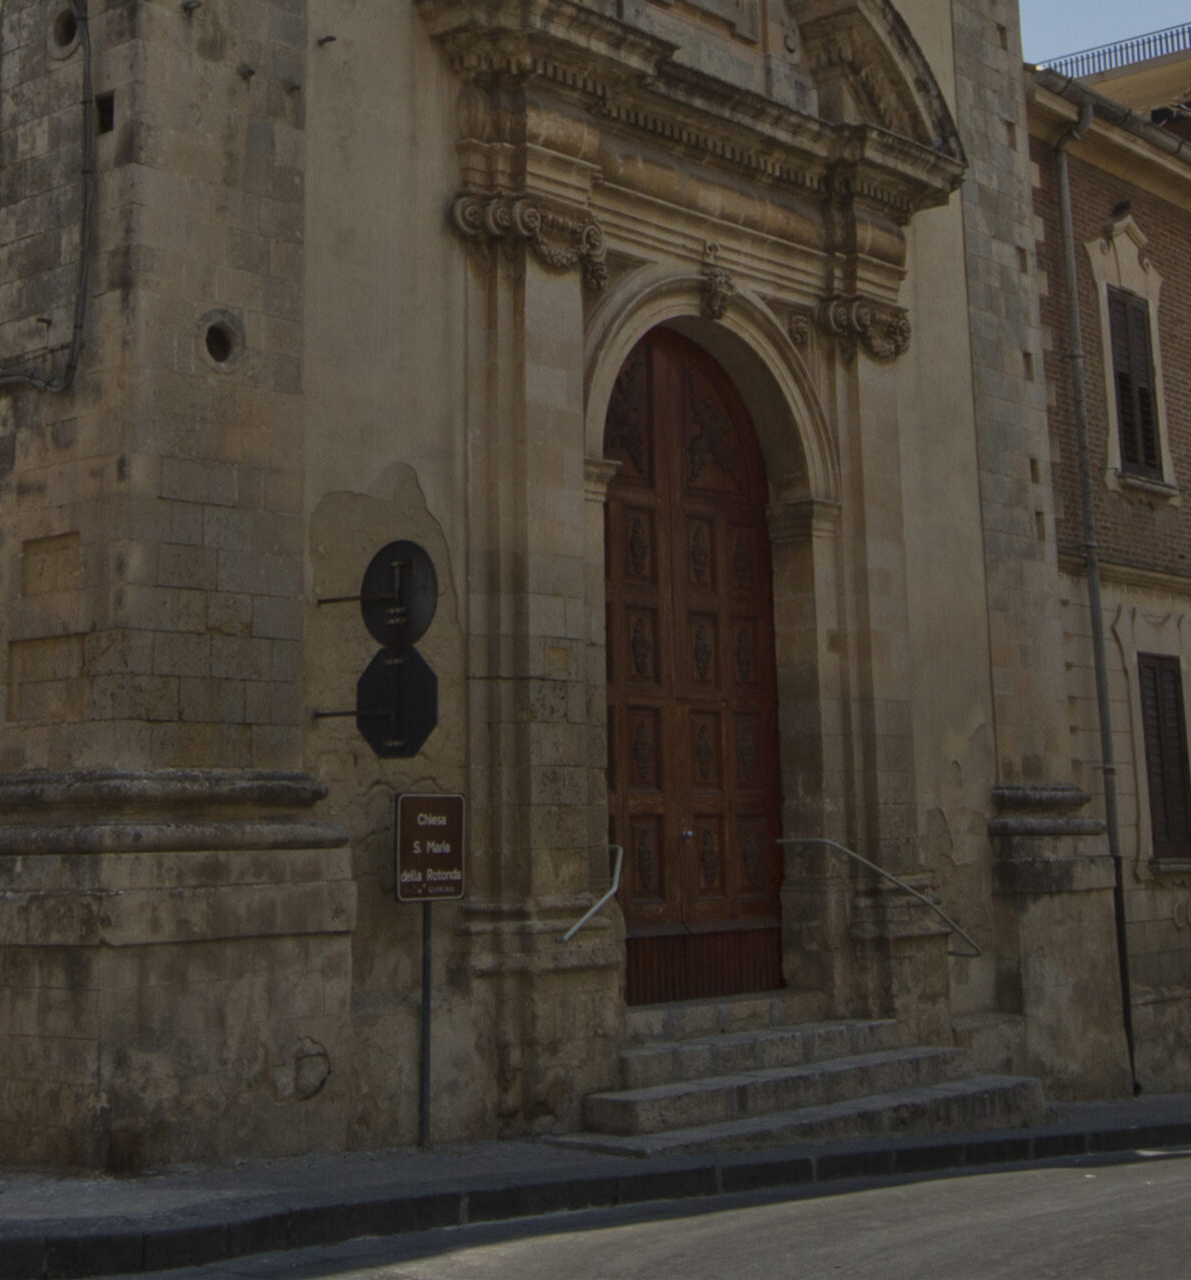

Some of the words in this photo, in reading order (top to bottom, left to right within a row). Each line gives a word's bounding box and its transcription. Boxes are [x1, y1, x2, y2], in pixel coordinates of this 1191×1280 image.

[417, 813, 447, 826] Chiesa
[413, 841, 422, 854] S.
[426, 841, 451, 854] Maria
[400, 869, 422, 882] della
[426, 868, 461, 881] Rotonda
